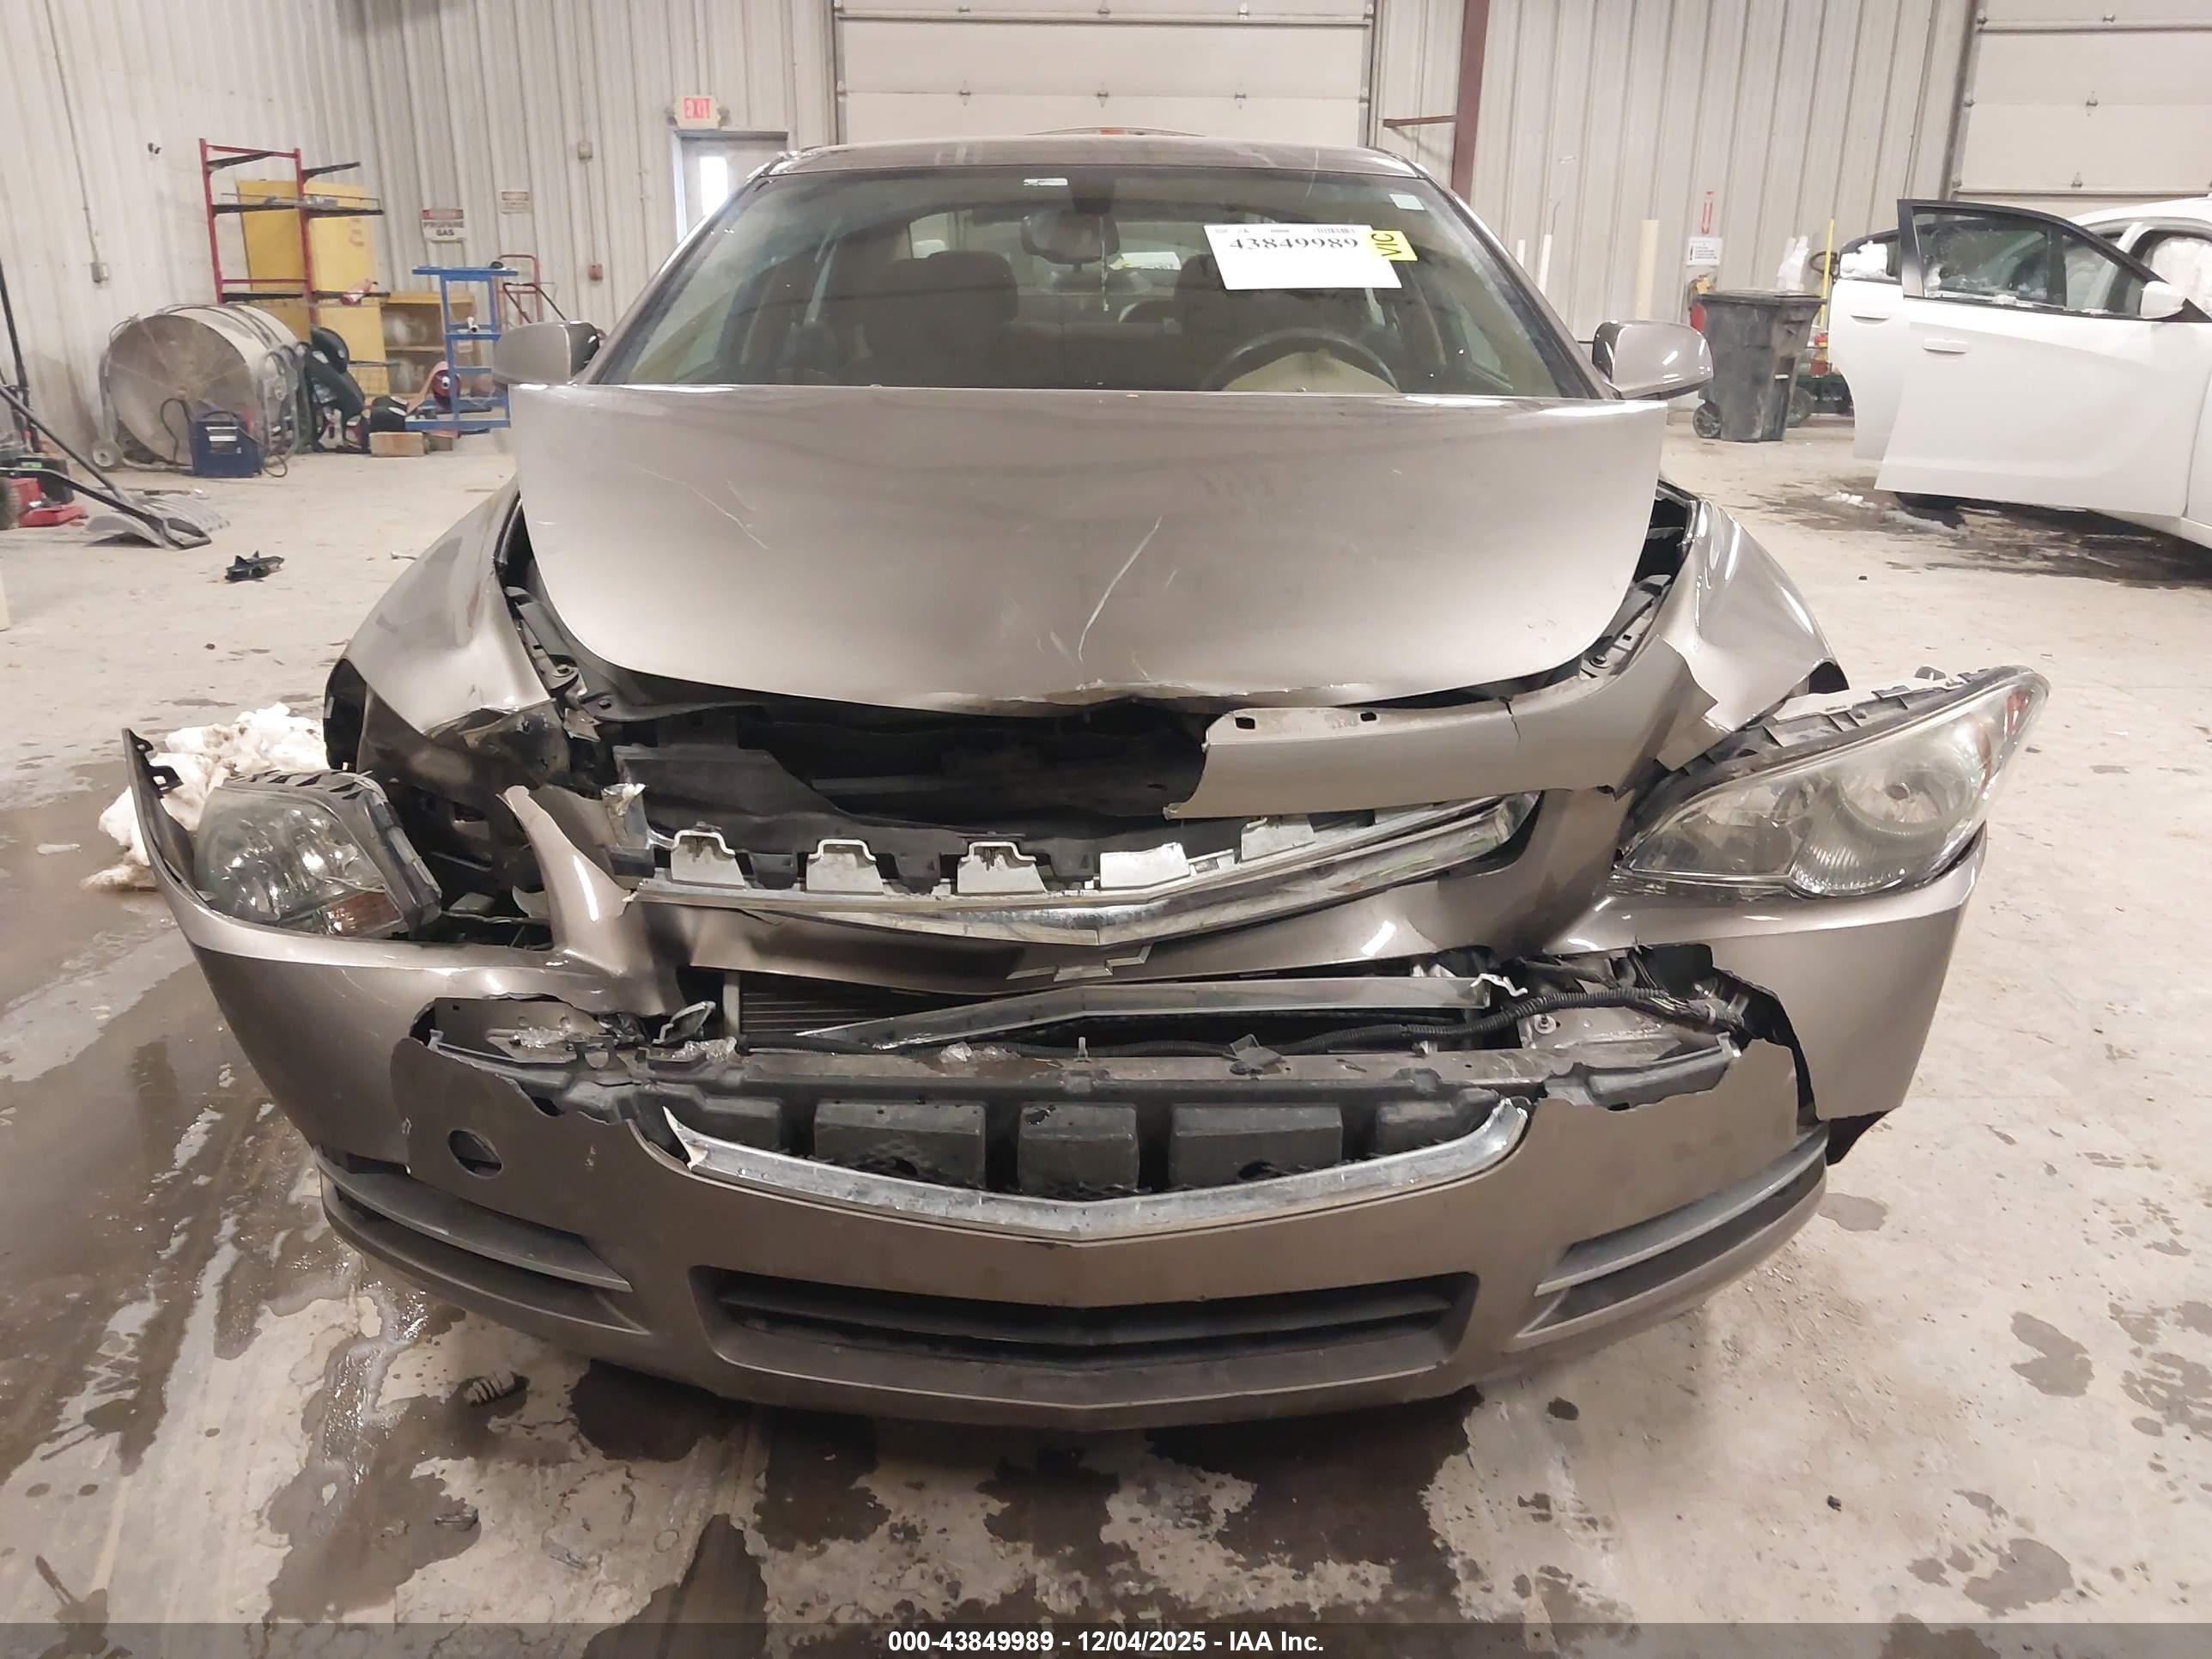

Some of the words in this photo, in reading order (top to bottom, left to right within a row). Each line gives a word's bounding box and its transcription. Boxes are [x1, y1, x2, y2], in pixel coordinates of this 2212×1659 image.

[684, 97, 710, 118] EXIT
[1229, 237, 1359, 250] 43849989
[1370, 233, 1402, 257] VIC
